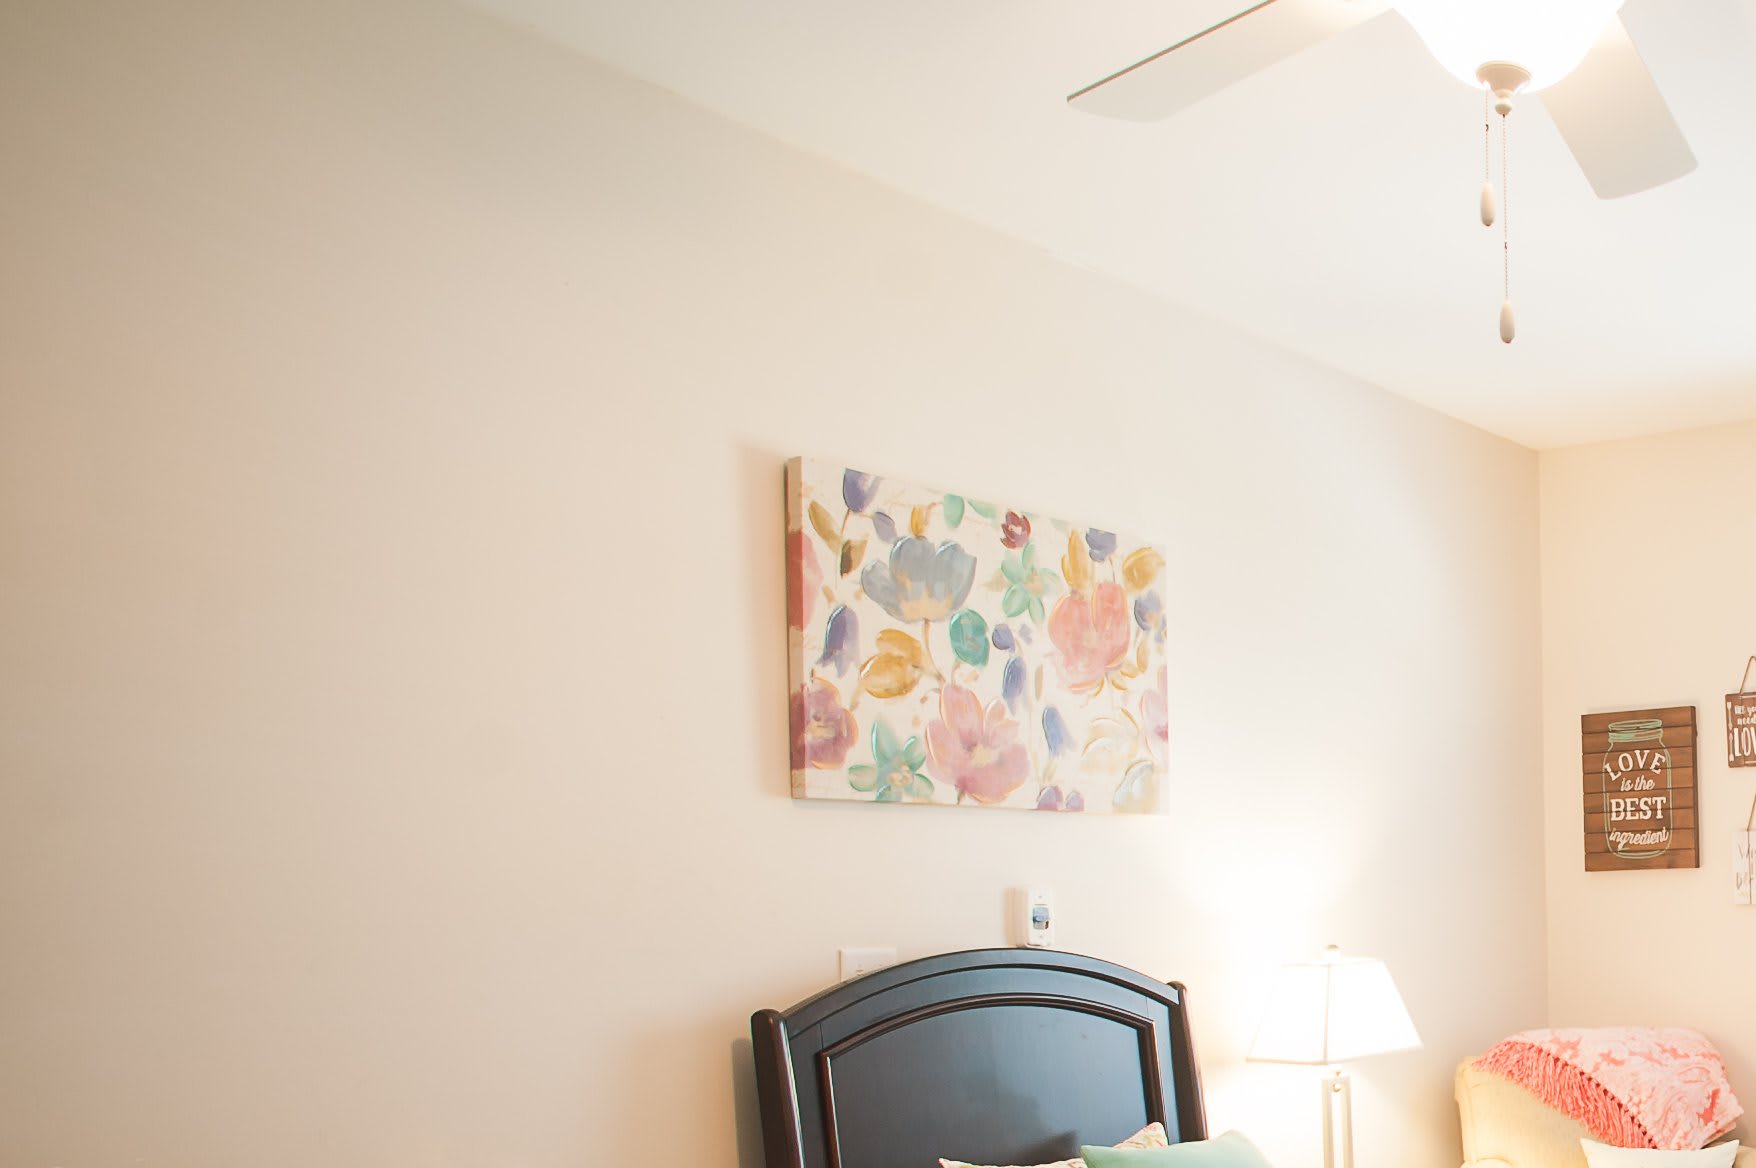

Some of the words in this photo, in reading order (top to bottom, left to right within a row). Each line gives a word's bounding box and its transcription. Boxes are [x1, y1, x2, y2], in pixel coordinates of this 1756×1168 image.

[1737, 713, 1756, 725] need
[1604, 750, 1666, 781] LOVE
[1621, 777, 1633, 792] is
[1634, 775, 1655, 791] the
[1610, 797, 1666, 821] BEST
[1609, 826, 1669, 852] ingredient
